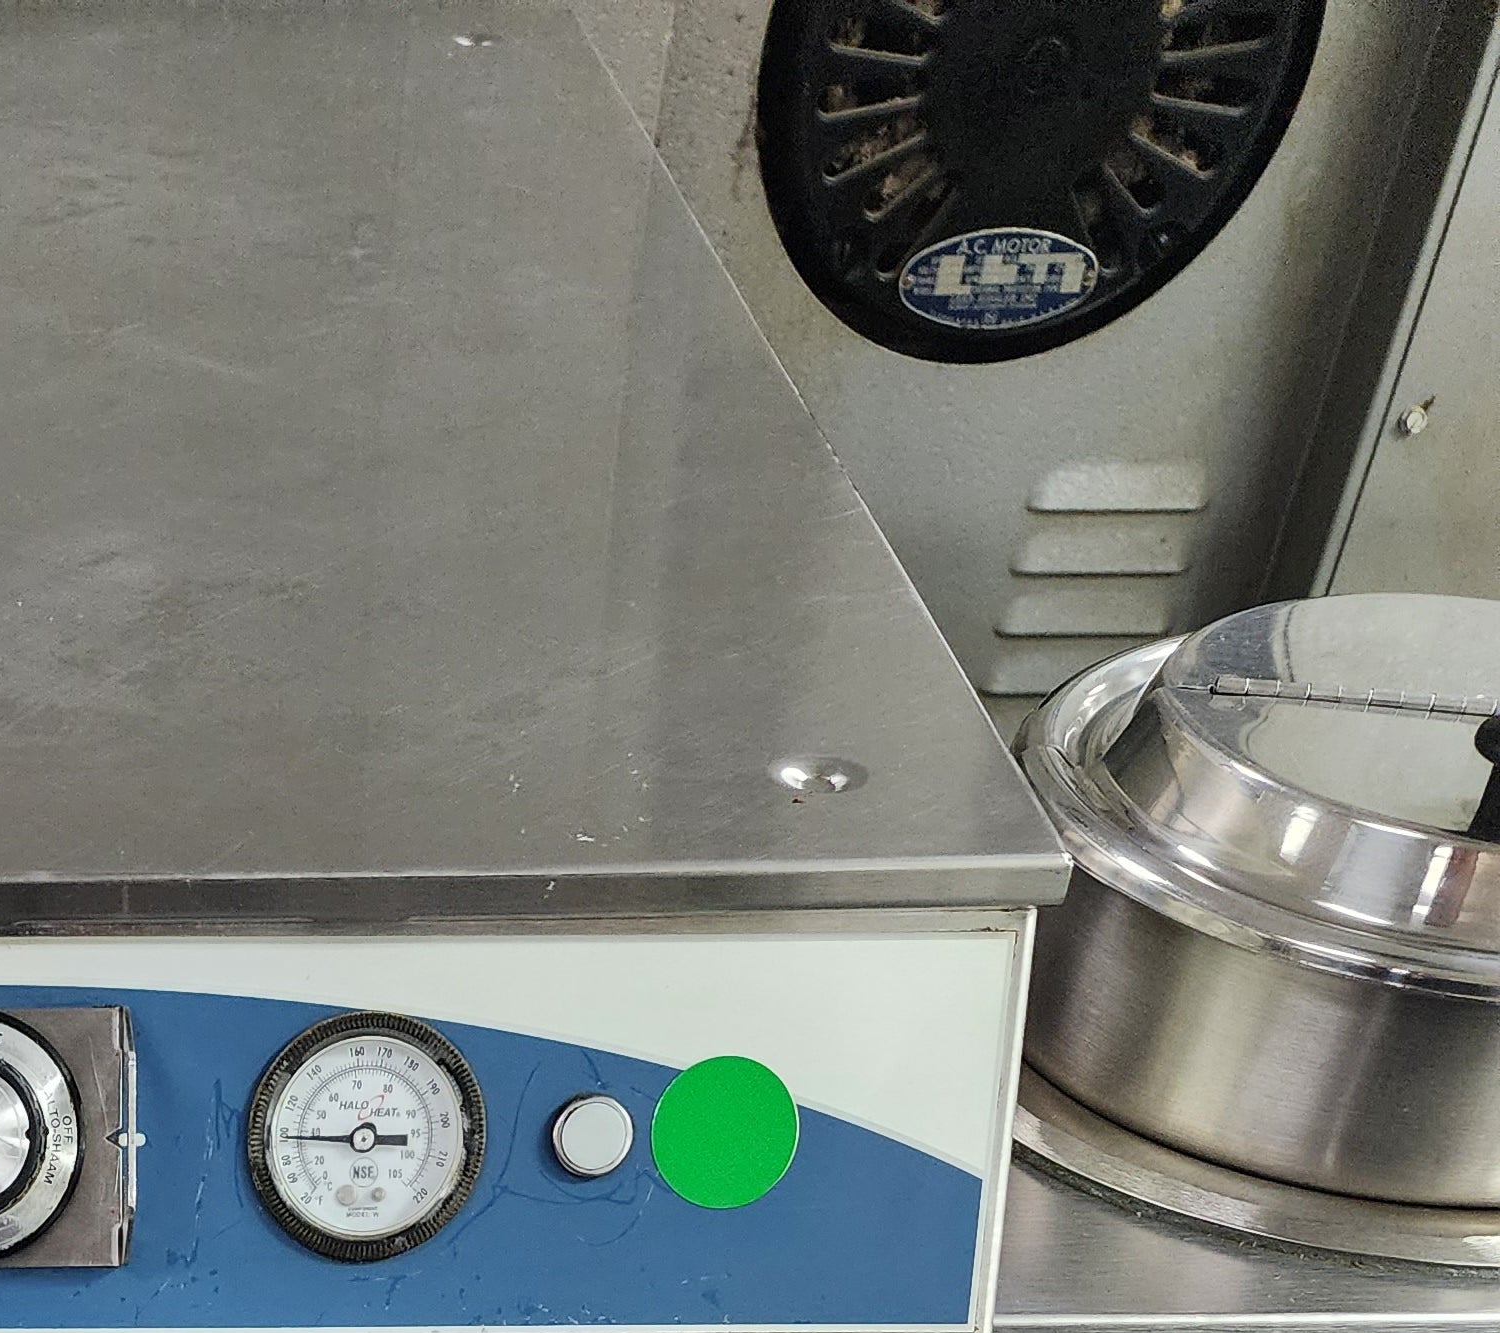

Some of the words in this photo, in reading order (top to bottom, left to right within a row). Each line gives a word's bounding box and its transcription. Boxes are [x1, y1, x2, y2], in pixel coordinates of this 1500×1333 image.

[991, 237, 1053, 254] MOTOR
[350, 1046, 365, 1057] 160
[377, 1047, 392, 1059] 170
[403, 1055, 419, 1072] 180
[306, 1064, 322, 1080] 140
[352, 1080, 363, 1090] 70
[383, 1084, 393, 1093] 80
[427, 1078, 441, 1096] 190
[285, 1095, 299, 1112] 120
[329, 1093, 339, 1102] 60
[339, 1100, 369, 1110] HALO
[316, 1110, 326, 1120] 50
[406, 1109, 416, 1119] 90
[440, 1112, 450, 1129] 200
[62, 1115, 73, 1144] OFF
[280, 1127, 289, 1143] 100
[411, 1129, 421, 1138] 95
[43, 1090, 62, 1184] ALTO-SHAAM
[314, 1155, 324, 1165] 20
[400, 1150, 415, 1160] 100
[435, 1150, 448, 1168] 210
[287, 1173, 298, 1184] 60
[323, 1171, 328, 1180] 0
[353, 1166, 375, 1179] NSF
[388, 1169, 403, 1179] 105
[300, 1192, 313, 1205] 20
[412, 1187, 428, 1205] 220
